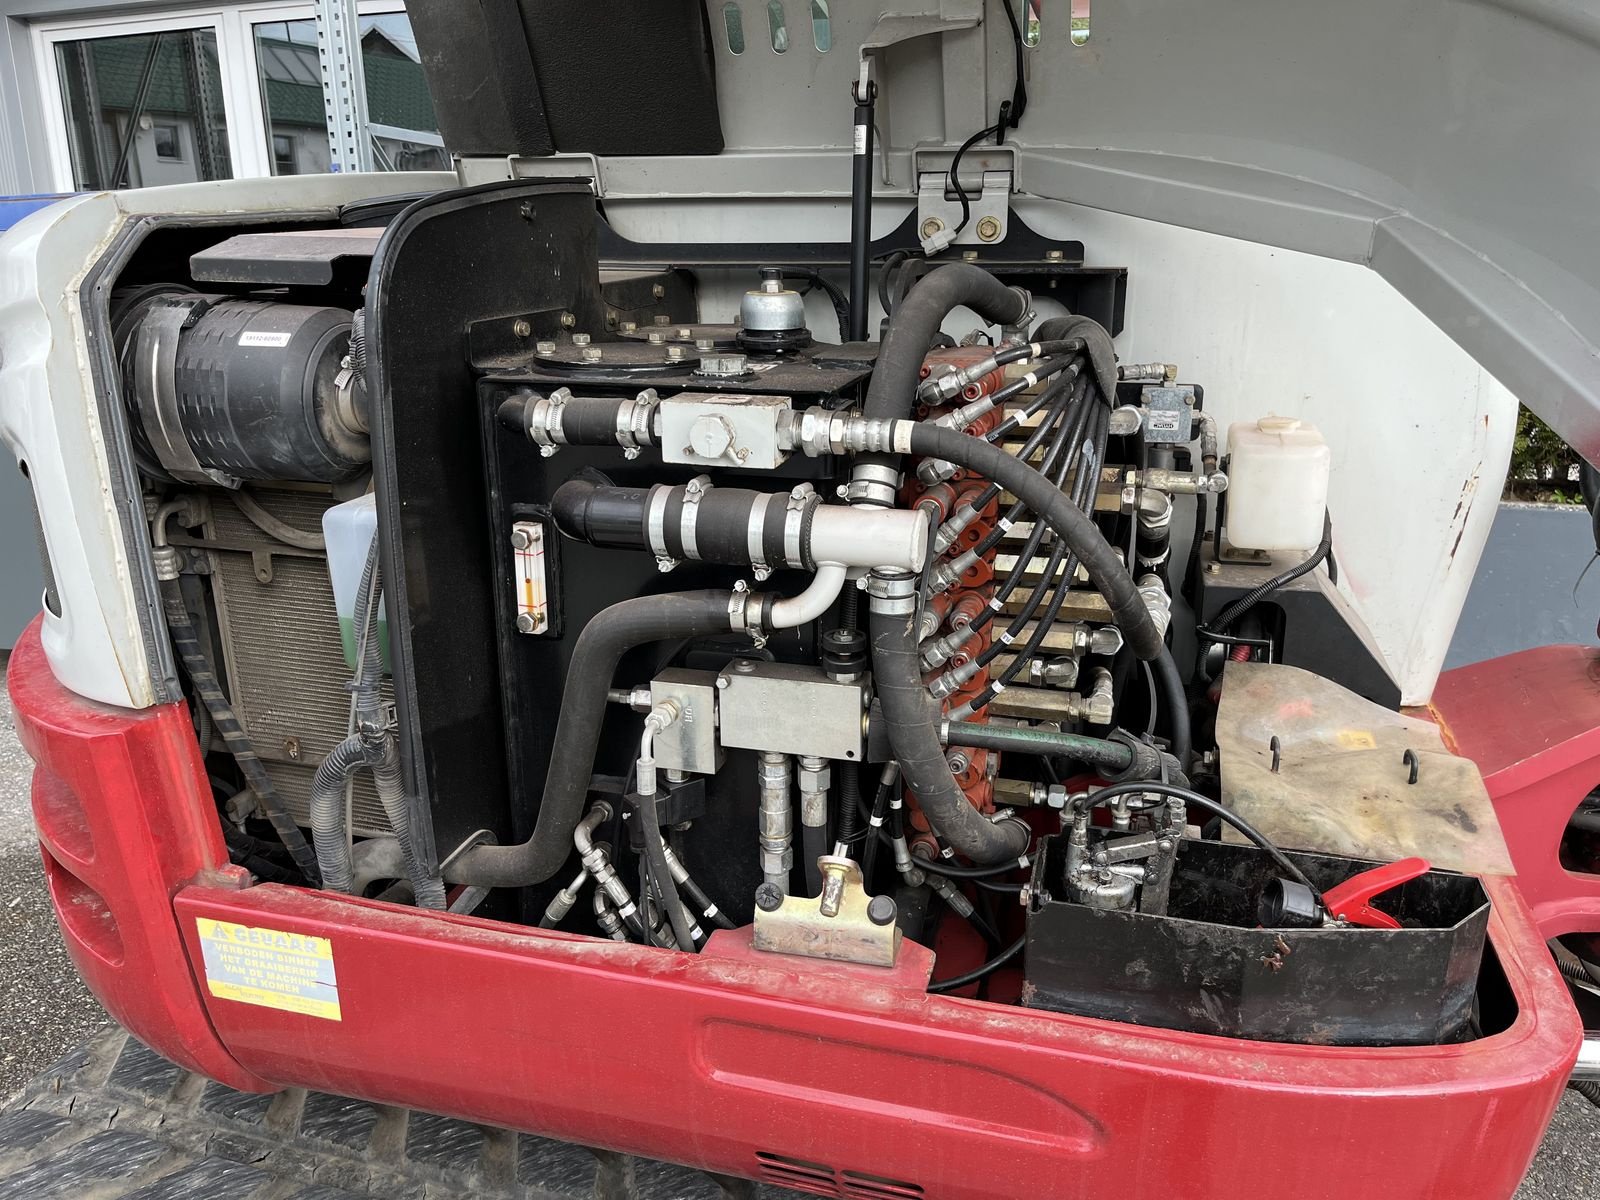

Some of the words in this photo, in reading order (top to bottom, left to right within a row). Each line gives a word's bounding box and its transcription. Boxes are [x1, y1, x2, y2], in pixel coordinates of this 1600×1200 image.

[234, 928, 318, 953] GEVAAR
[214, 943, 273, 960] VERBODEN
[277, 953, 319, 968] BINNEN
[220, 954, 240, 964] HET
[223, 964, 245, 975] VAN
[249, 969, 263, 978] DE
[266, 971, 317, 988] MACHINE
[244, 976, 257, 986] TE
[261, 979, 299, 994] KOMEN
